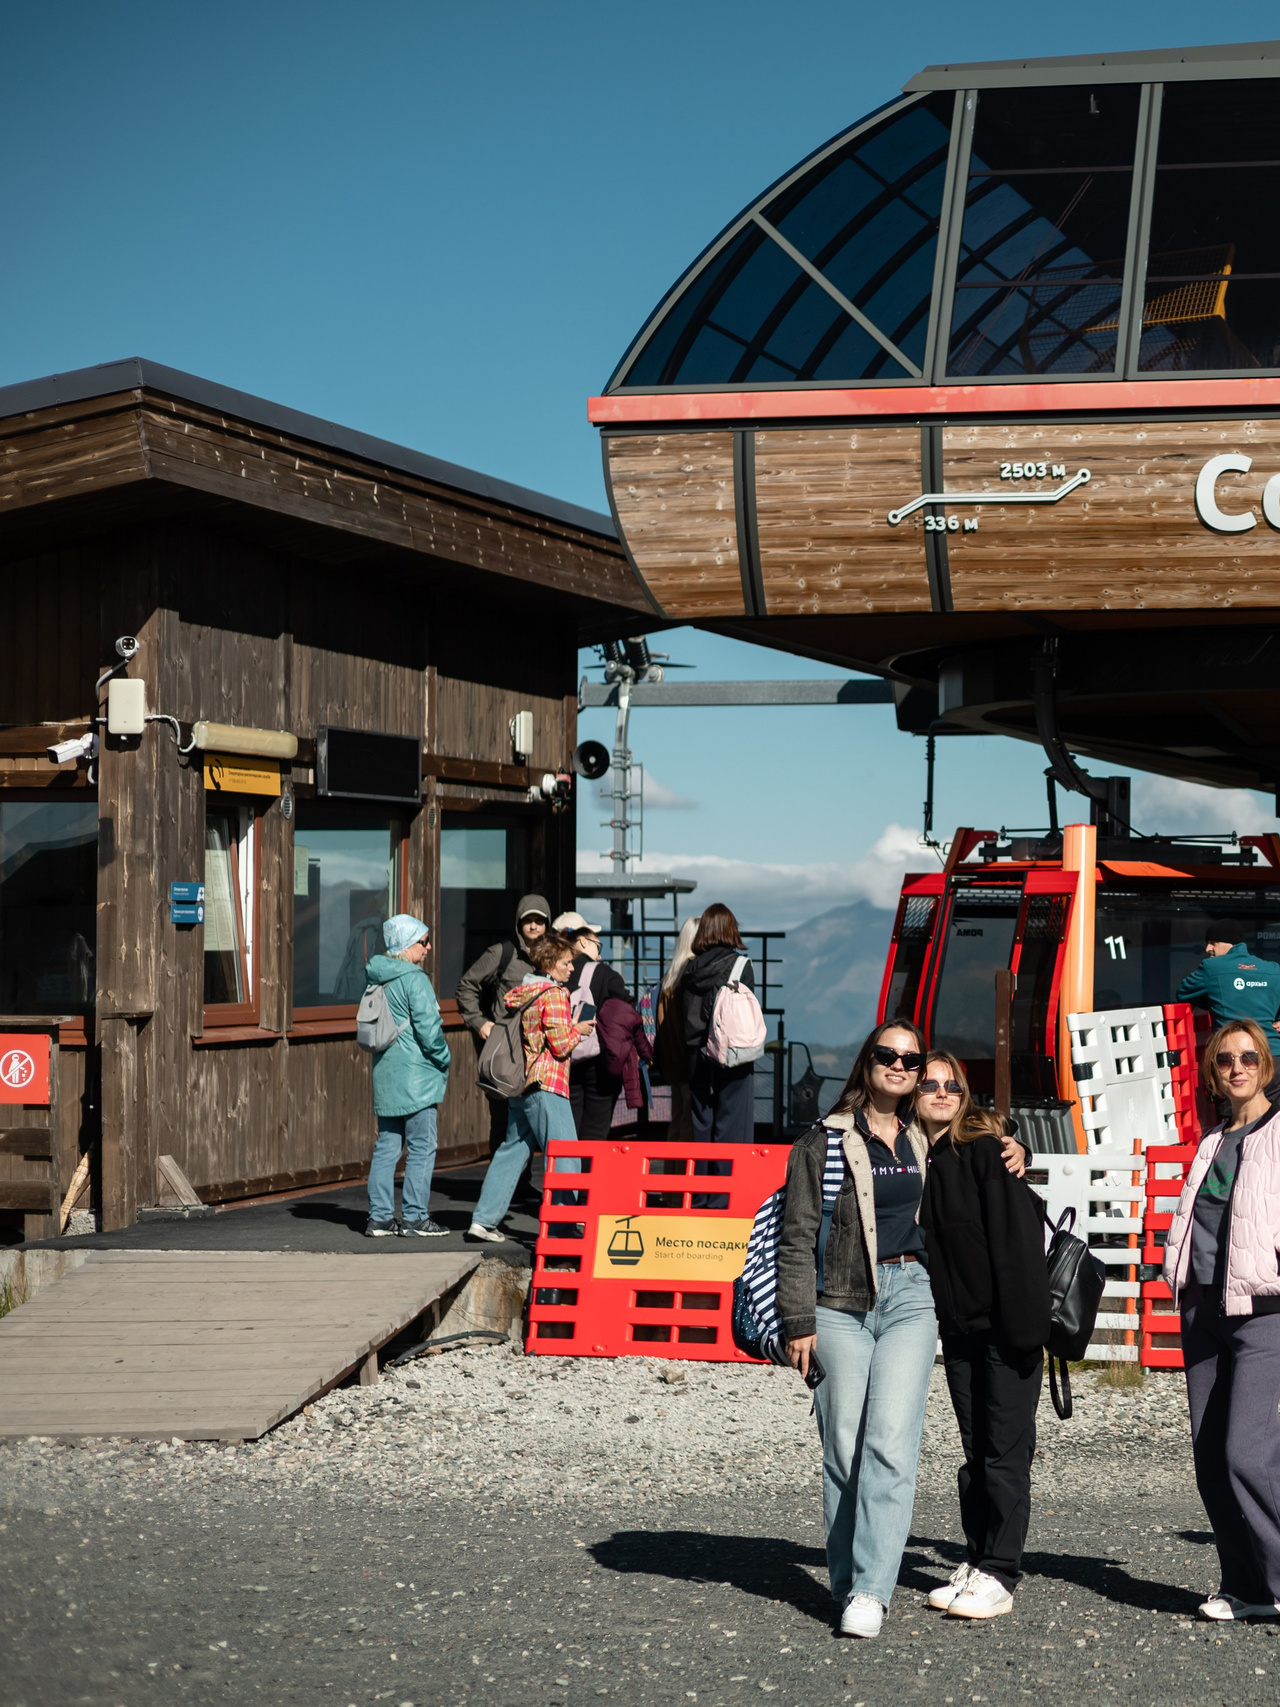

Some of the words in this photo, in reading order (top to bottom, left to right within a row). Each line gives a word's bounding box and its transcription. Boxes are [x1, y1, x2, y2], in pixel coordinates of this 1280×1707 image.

[1000, 462, 1047, 478] 2503
[1051, 464, 1067, 477] м
[924, 515, 960, 531] 336
[963, 518, 979, 531] м
[1104, 935, 1127, 960] 11
[655, 1236, 694, 1248] Место
[696, 1240, 749, 1251] посадки
[654, 1251, 674, 1259] Start
[675, 1251, 684, 1259] of
[686, 1252, 724, 1262] boarding
